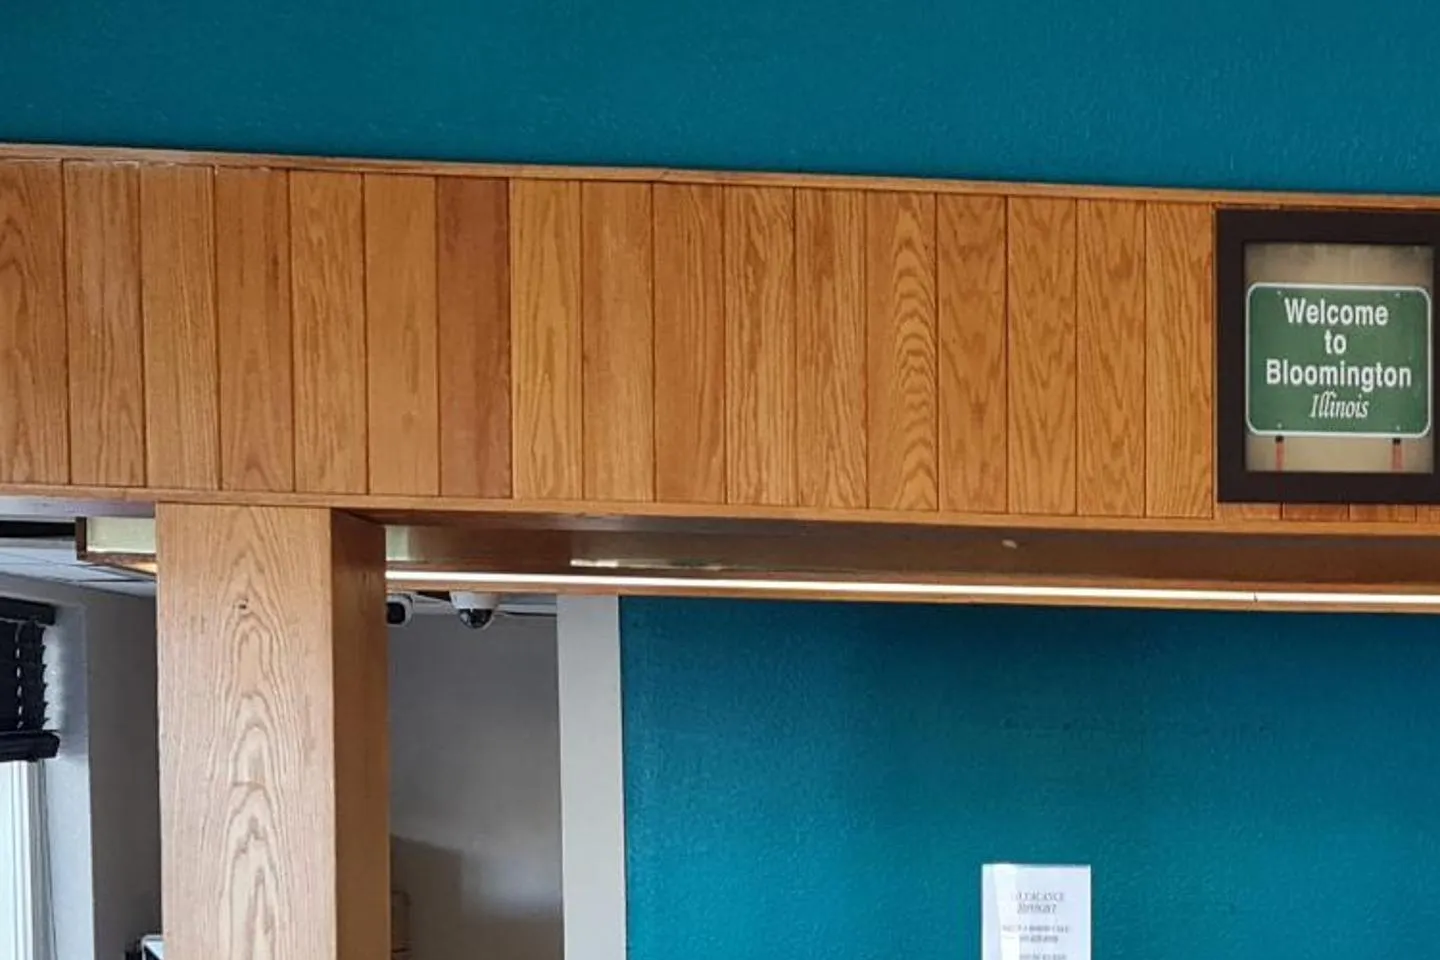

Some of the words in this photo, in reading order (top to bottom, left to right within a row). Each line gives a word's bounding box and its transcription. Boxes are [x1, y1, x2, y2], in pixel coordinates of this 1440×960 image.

[1284, 297, 1389, 326] Welcome
[1324, 330, 1347, 354] to
[1266, 358, 1412, 392] Bloomington
[1309, 391, 1370, 418] Illinois
